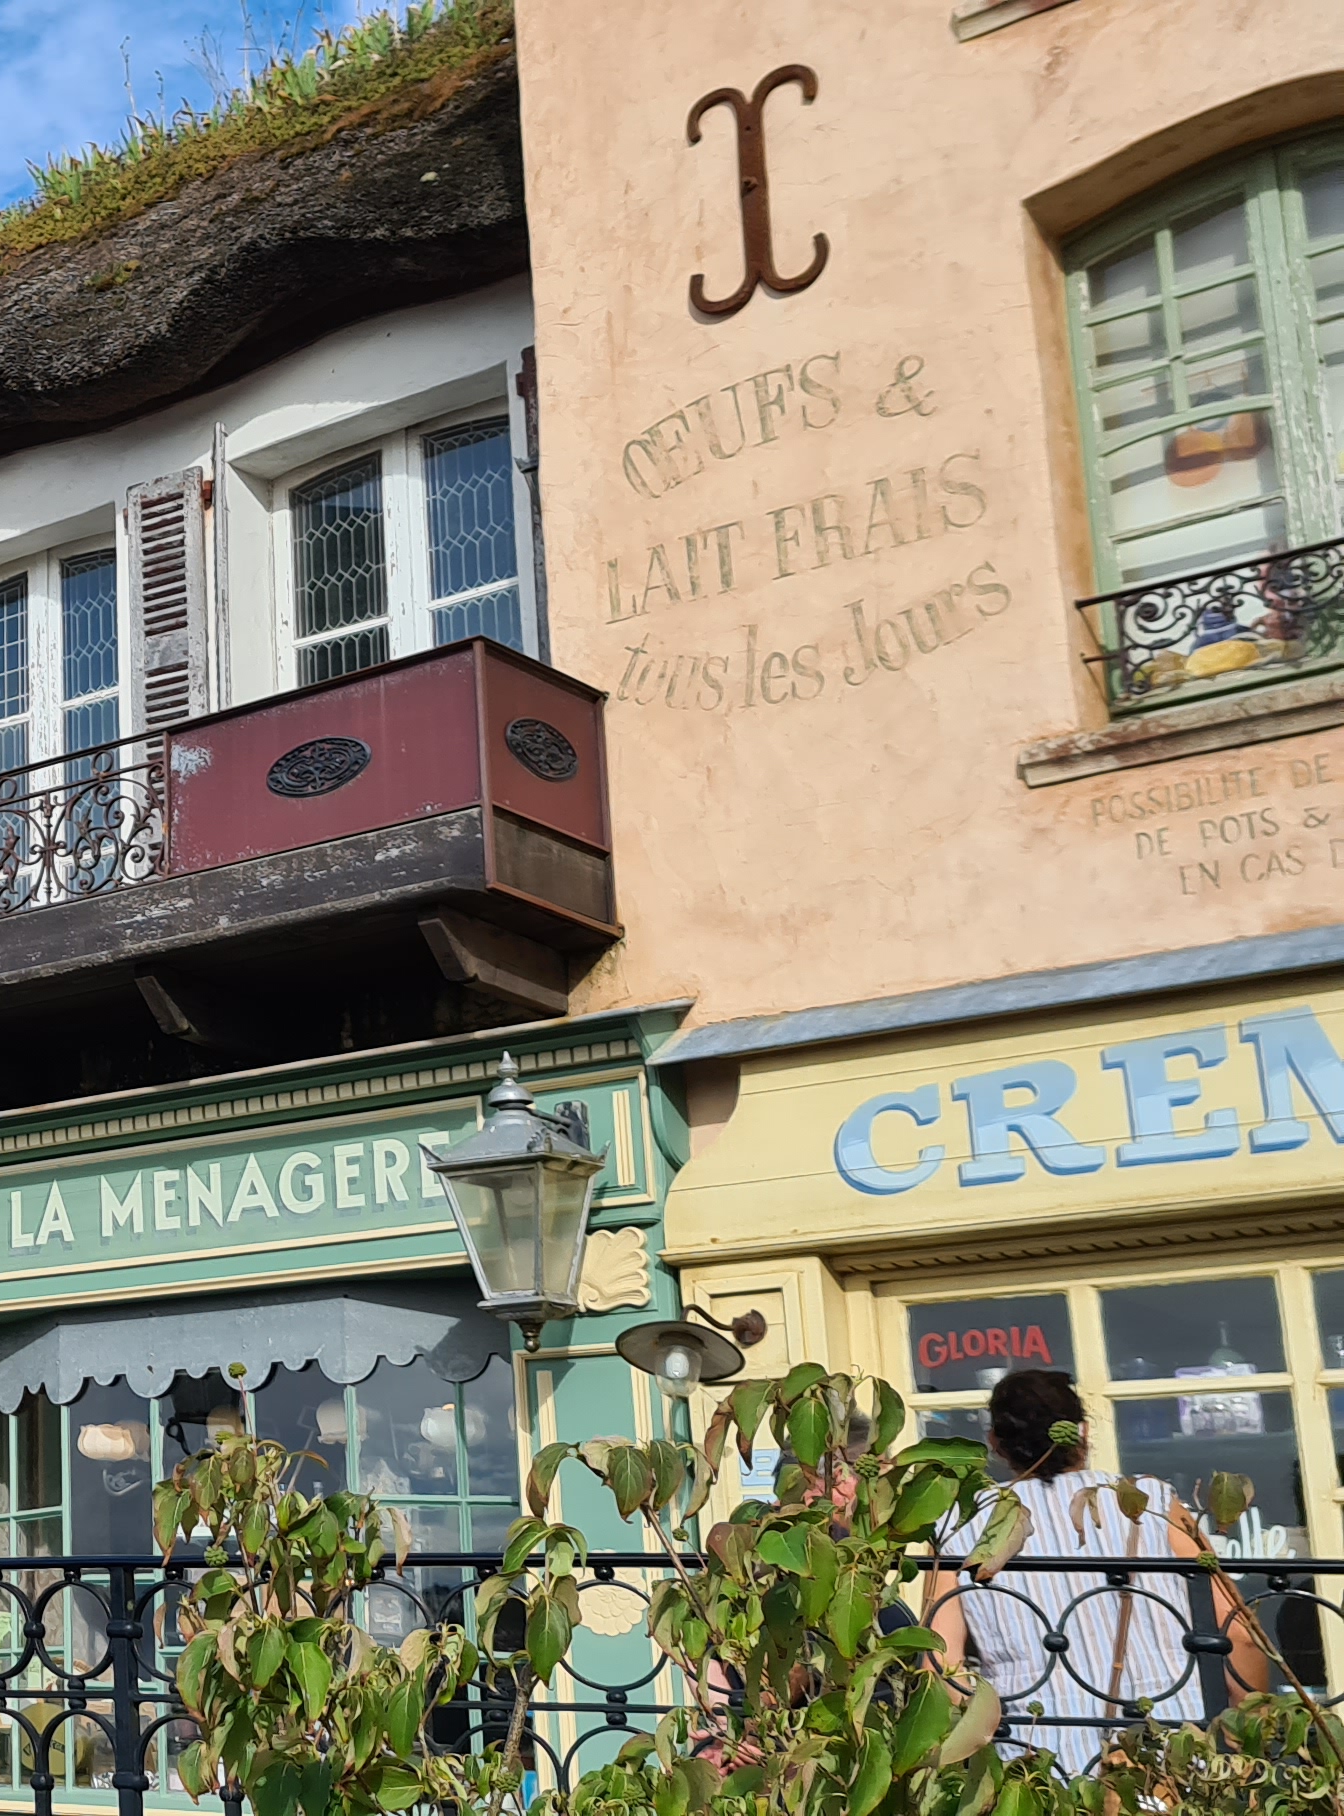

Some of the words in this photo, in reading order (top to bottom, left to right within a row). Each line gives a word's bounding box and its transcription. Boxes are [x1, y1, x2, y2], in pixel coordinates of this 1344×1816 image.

[876, 355, 939, 418] &
[605, 519, 746, 626] LAIT
[765, 449, 988, 582] FRAIS
[615, 631, 731, 711] tous
[743, 624, 827, 707] les
[842, 561, 1015, 686] Jours
[1290, 753, 1333, 788] DE
[1136, 827, 1171, 859] DE
[1199, 808, 1280, 847] POTS
[1303, 806, 1330, 828] &
[1179, 860, 1221, 895] EN
[1240, 845, 1306, 882] CAS
[10, 1180, 76, 1248] LA
[100, 1131, 451, 1237] MENAGERE
[918, 1326, 1052, 1369] GLORIA
